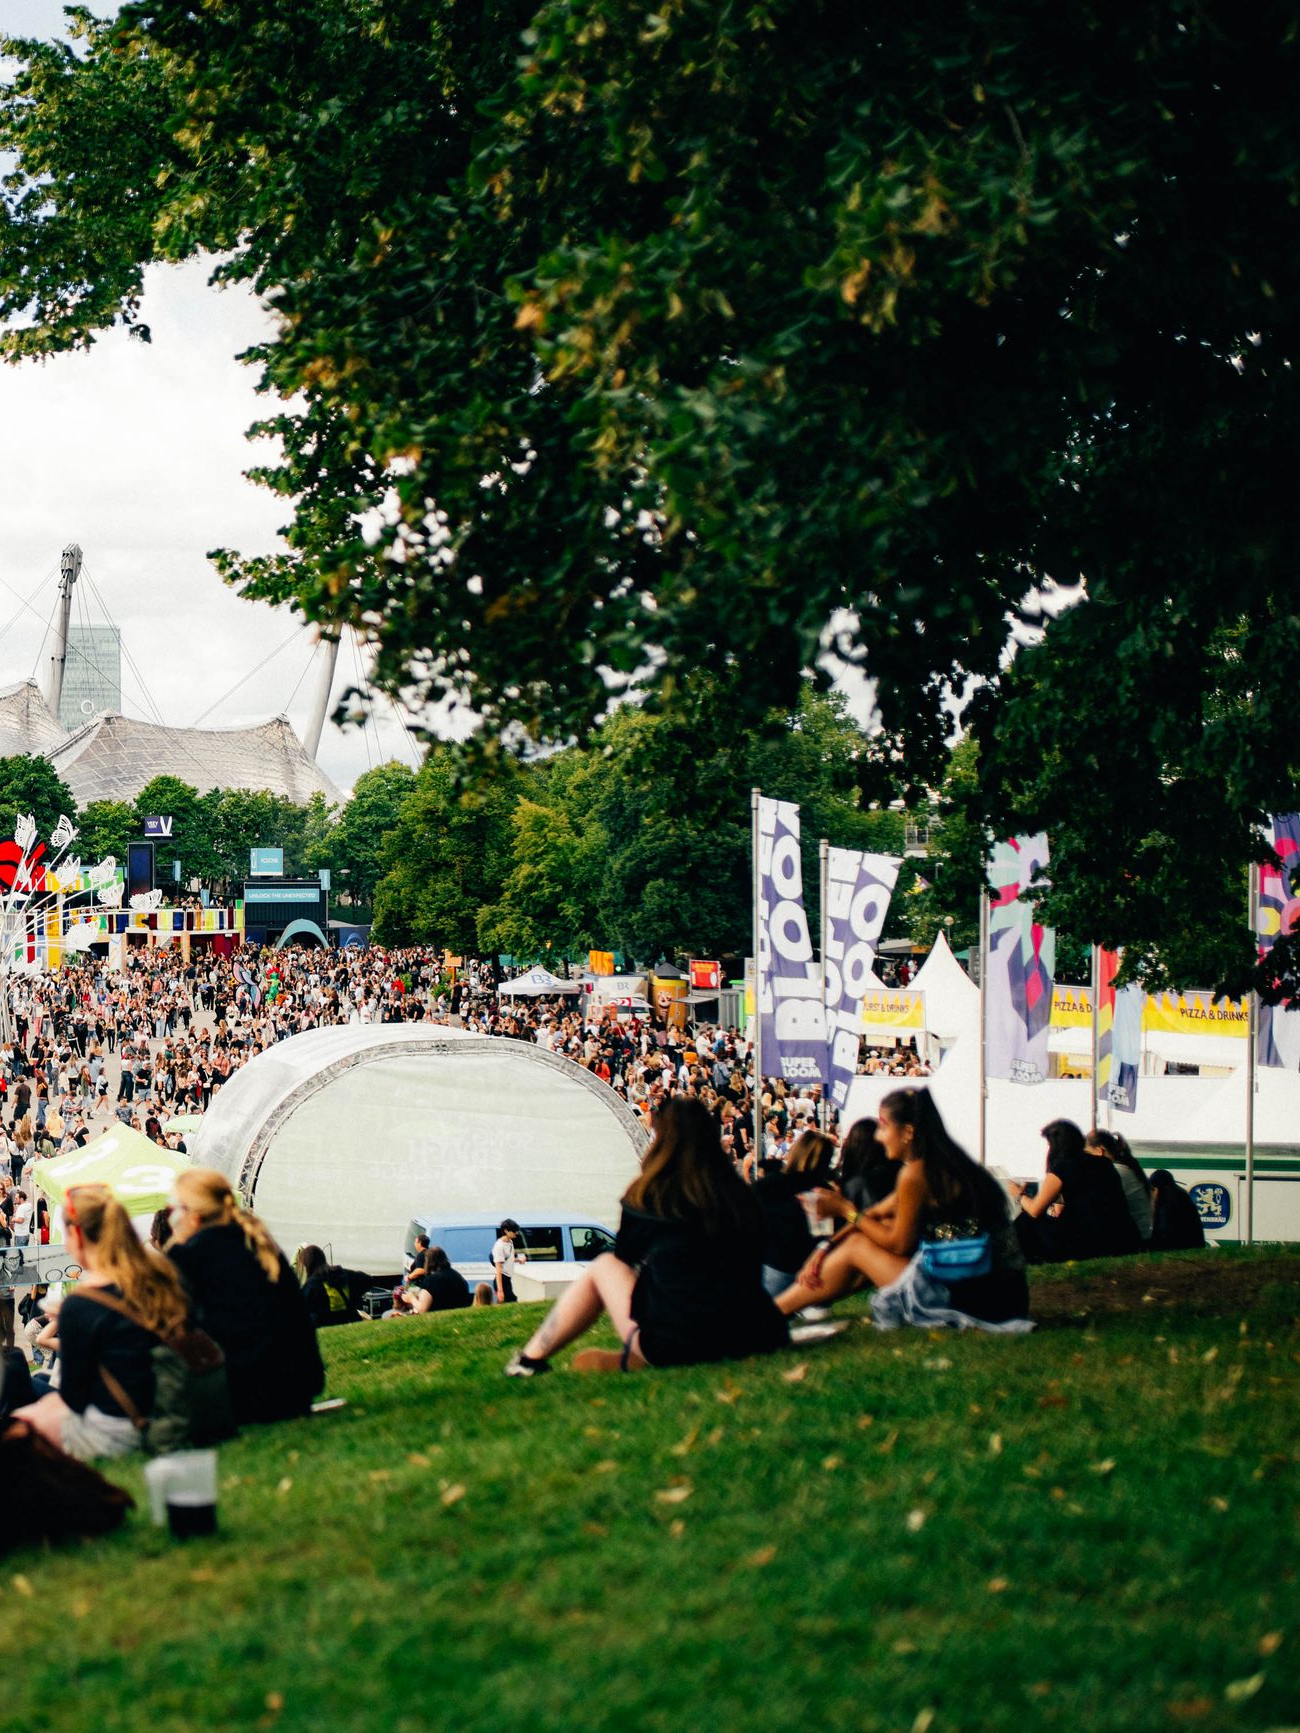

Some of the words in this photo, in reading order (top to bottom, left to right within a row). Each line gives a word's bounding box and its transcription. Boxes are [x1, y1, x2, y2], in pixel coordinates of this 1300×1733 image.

[617, 982, 629, 990] BR
[886, 1003, 909, 1013] DRINKS
[1053, 1001, 1077, 1012] PIZZA
[1079, 1004, 1085, 1012] &
[1180, 1008, 1207, 1019] PIZZA
[1209, 1010, 1216, 1019] &
[1217, 1010, 1249, 1022] DRINKS
[780, 1056, 817, 1067] SUPER
[782, 1066, 822, 1078] LOOM
